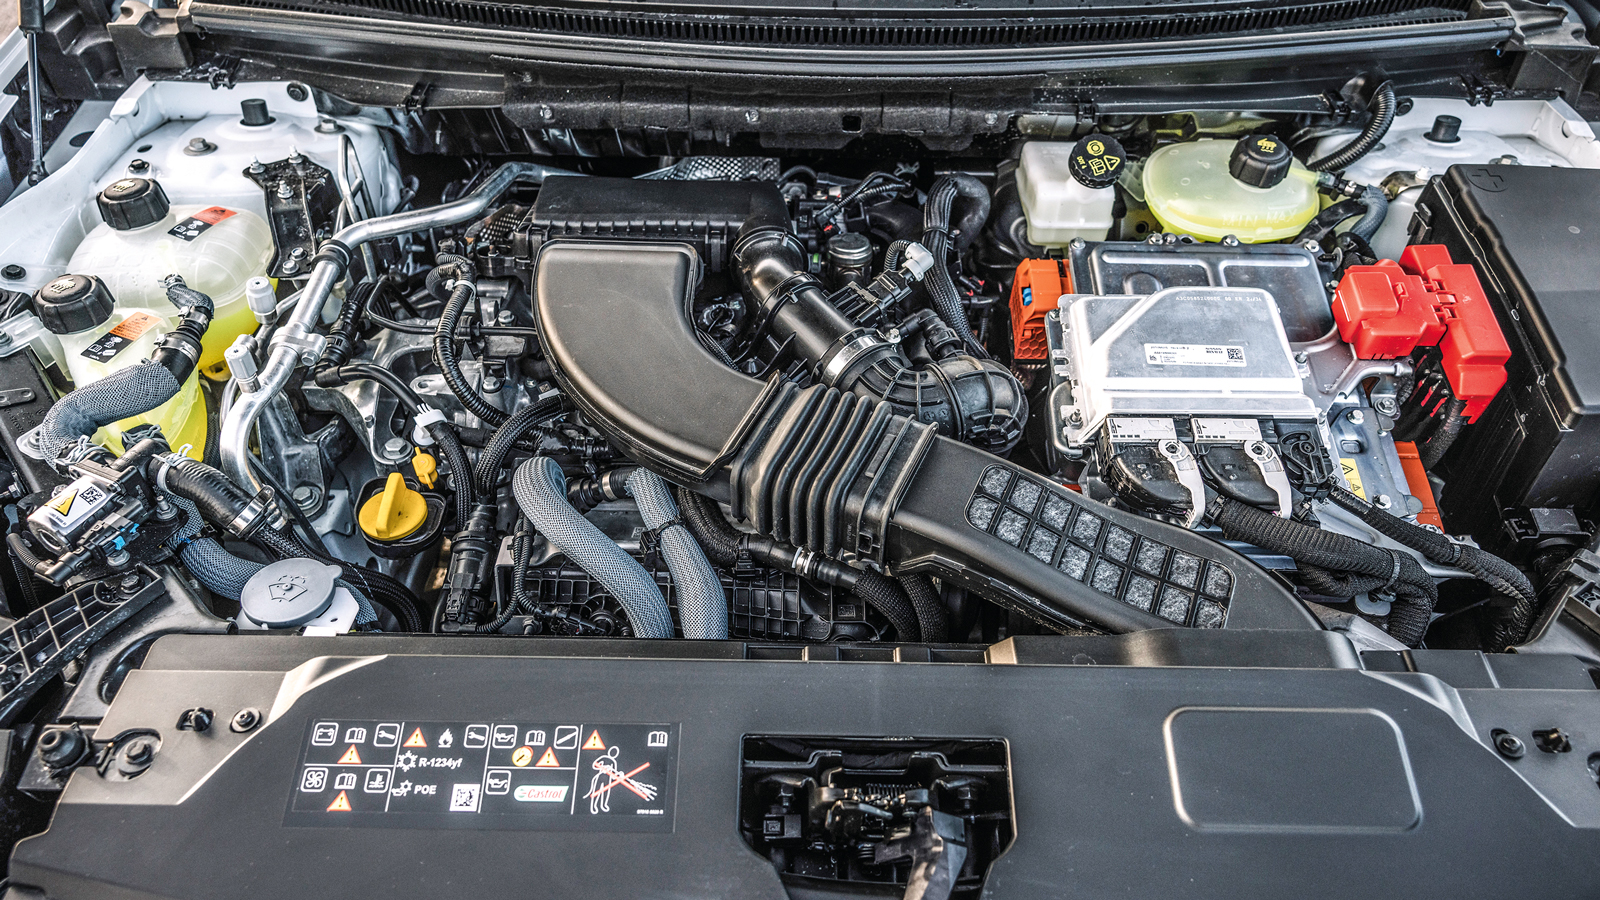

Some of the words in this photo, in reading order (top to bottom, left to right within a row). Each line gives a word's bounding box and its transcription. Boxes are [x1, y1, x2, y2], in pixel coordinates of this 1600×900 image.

[1222, 213, 1258, 227] MIN
[1265, 208, 1298, 224] MAX
[418, 757, 463, 770] R-1234yf
[413, 784, 438, 795] POE
[527, 788, 563, 799] Castrol
